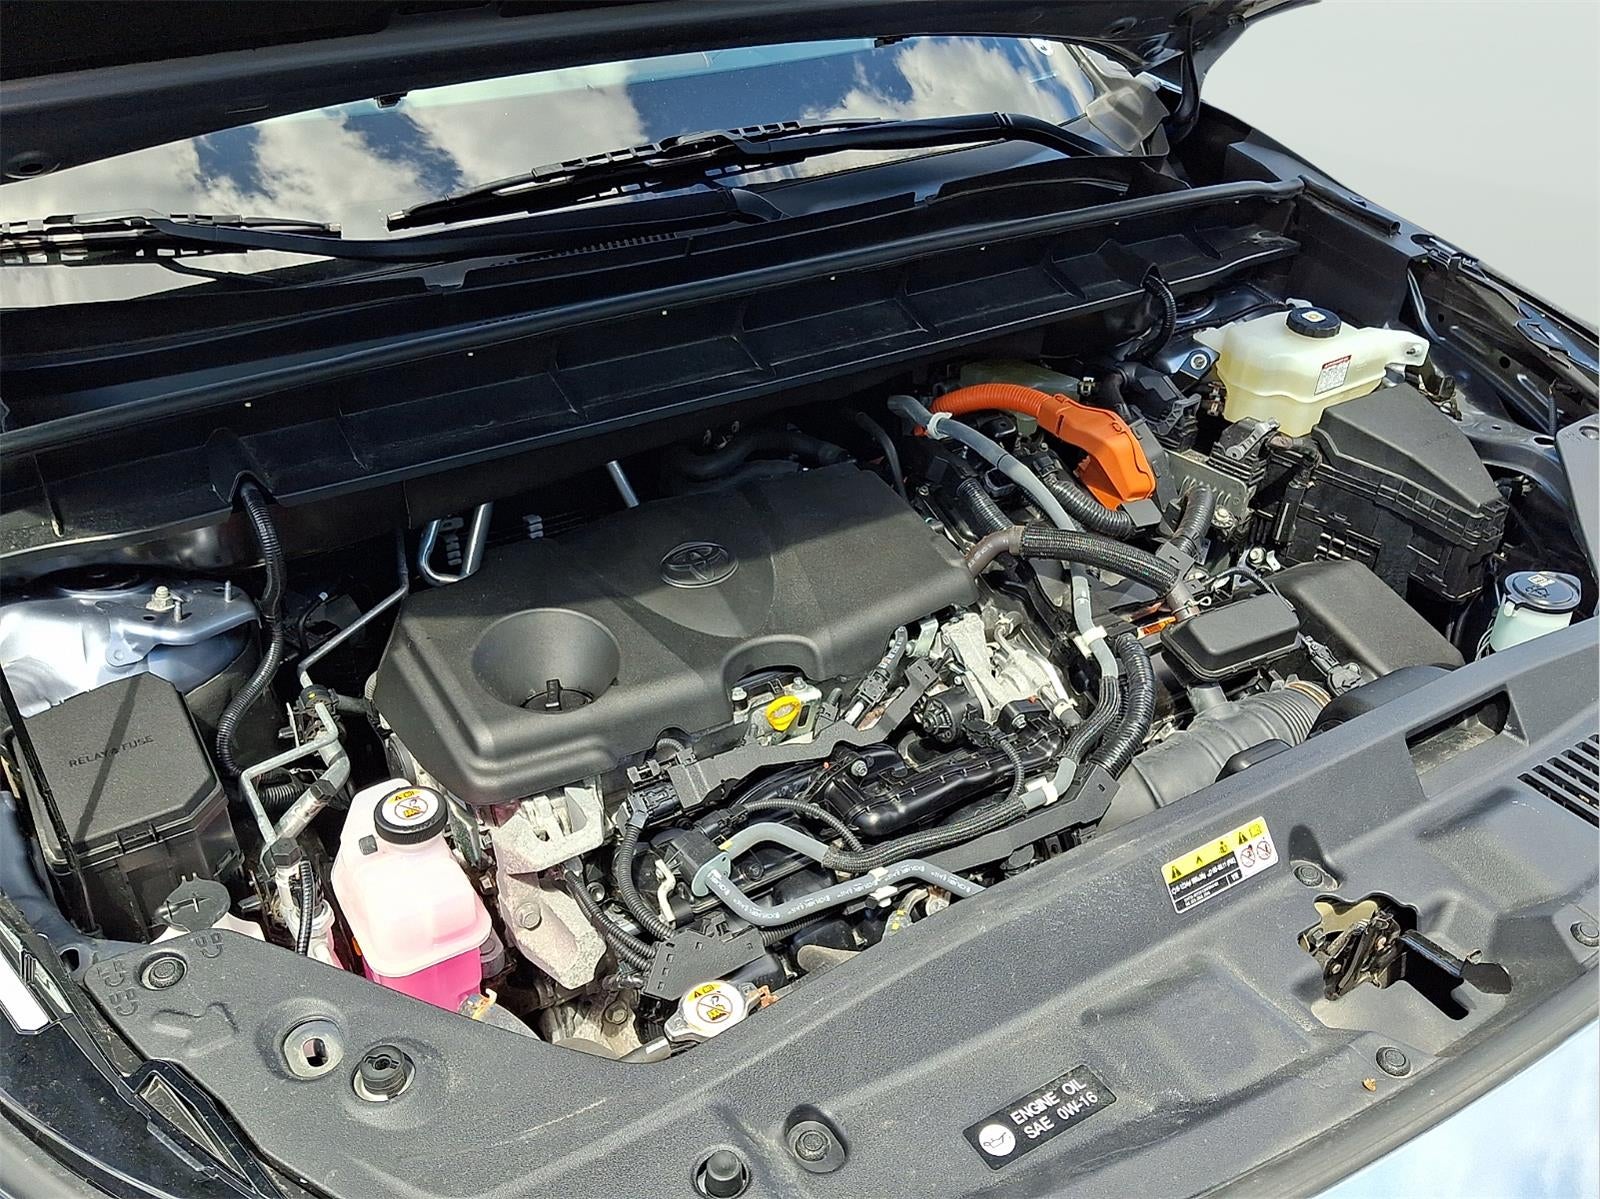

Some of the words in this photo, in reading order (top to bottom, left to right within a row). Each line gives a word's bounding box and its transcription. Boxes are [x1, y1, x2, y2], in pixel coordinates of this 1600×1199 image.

[121, 735, 154, 751] FUSE
[1010, 1091, 1060, 1125] ENGINE
[1061, 1079, 1087, 1096] OIL
[1023, 1115, 1055, 1139] SAE
[1056, 1091, 1099, 1120] 0W-16
